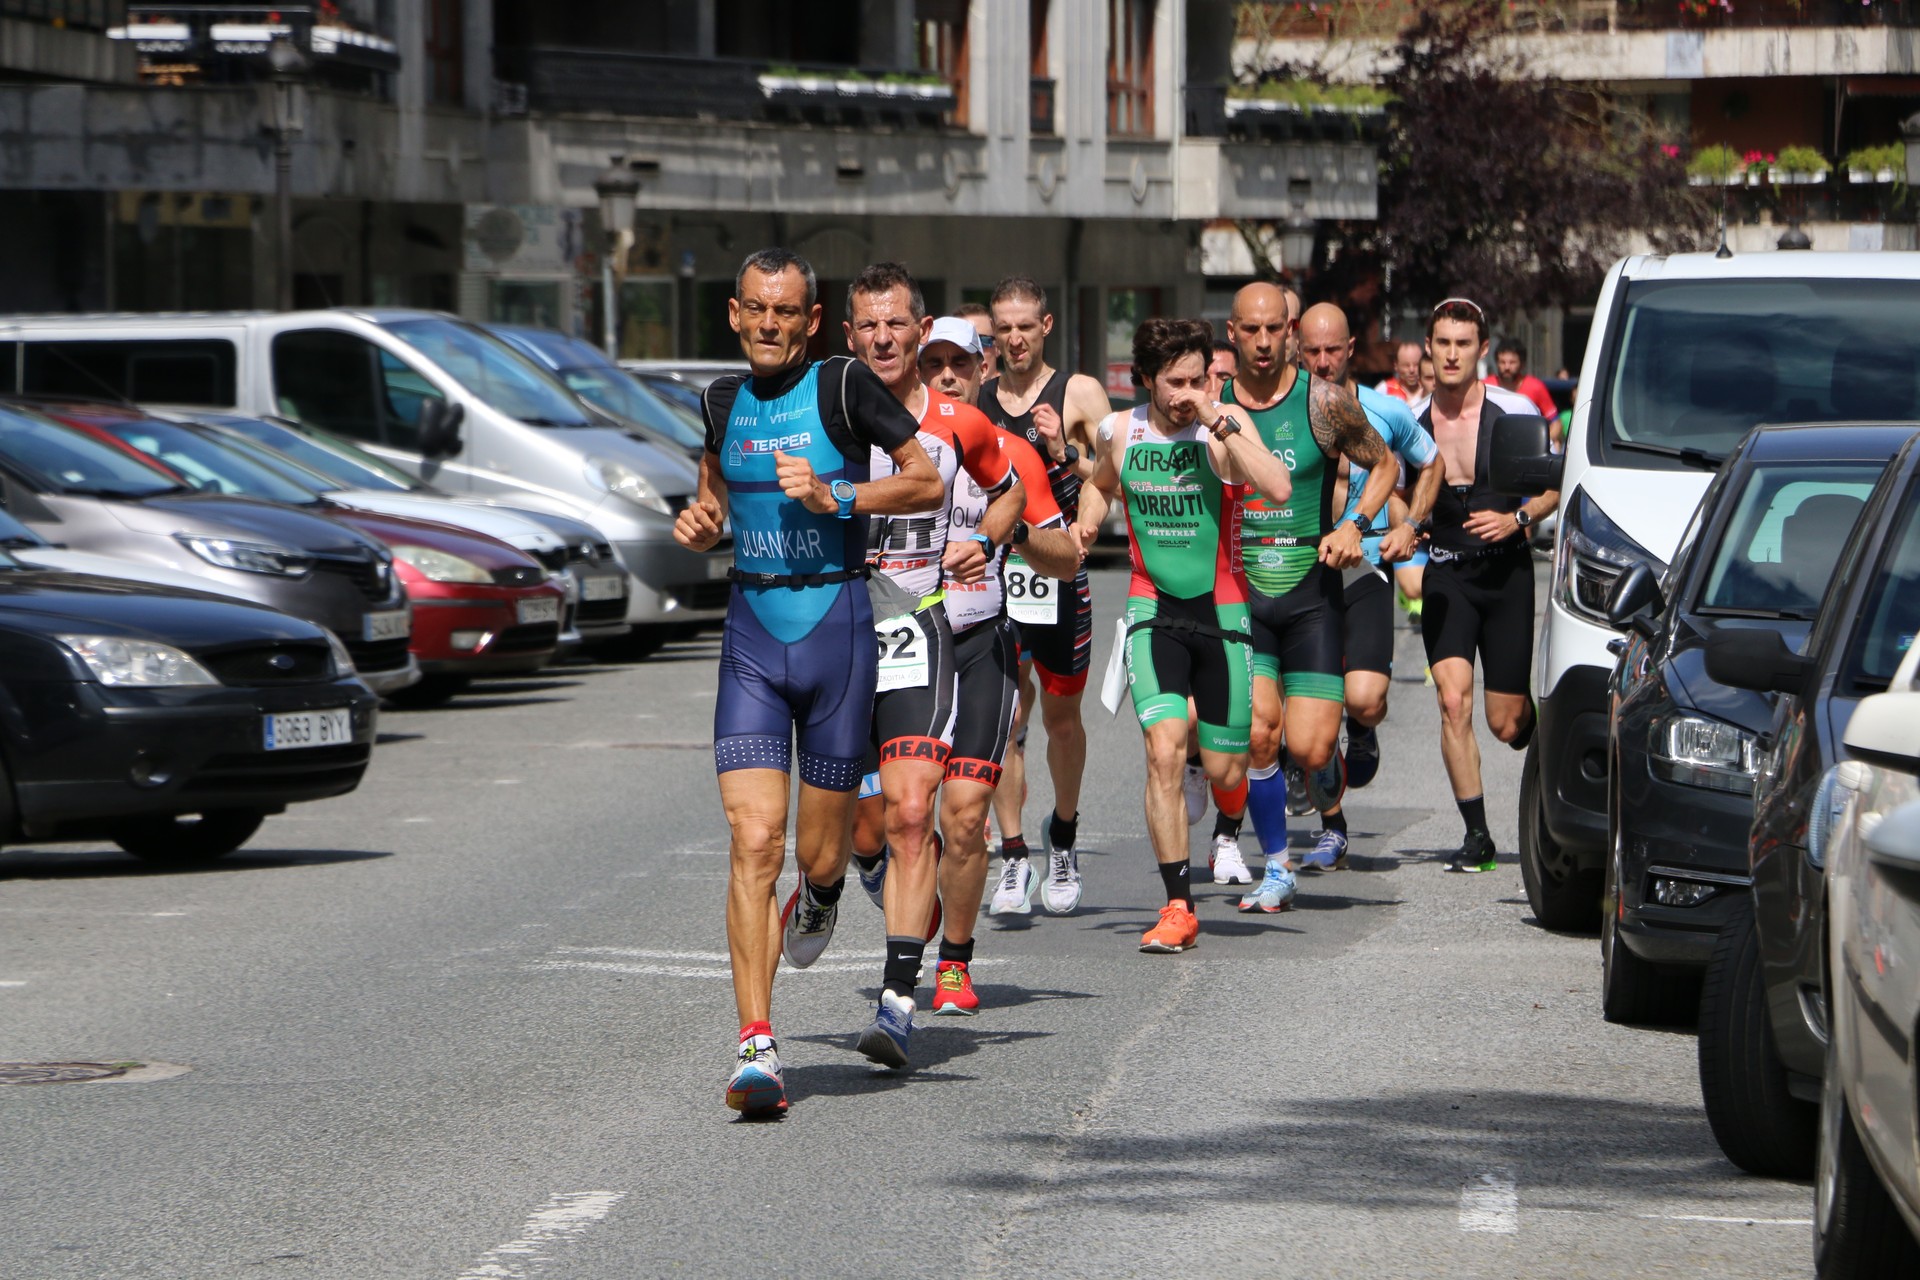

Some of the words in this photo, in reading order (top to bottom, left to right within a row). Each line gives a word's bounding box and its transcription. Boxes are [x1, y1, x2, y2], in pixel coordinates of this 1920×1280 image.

[743, 432, 811, 452] ATERPEA
[1130, 484, 1204, 493] YURREBASO
[1134, 494, 1204, 517] URRUTI
[1243, 508, 1293, 520] trayma
[742, 528, 824, 559] JUANKAR
[1007, 572, 1049, 599] 86
